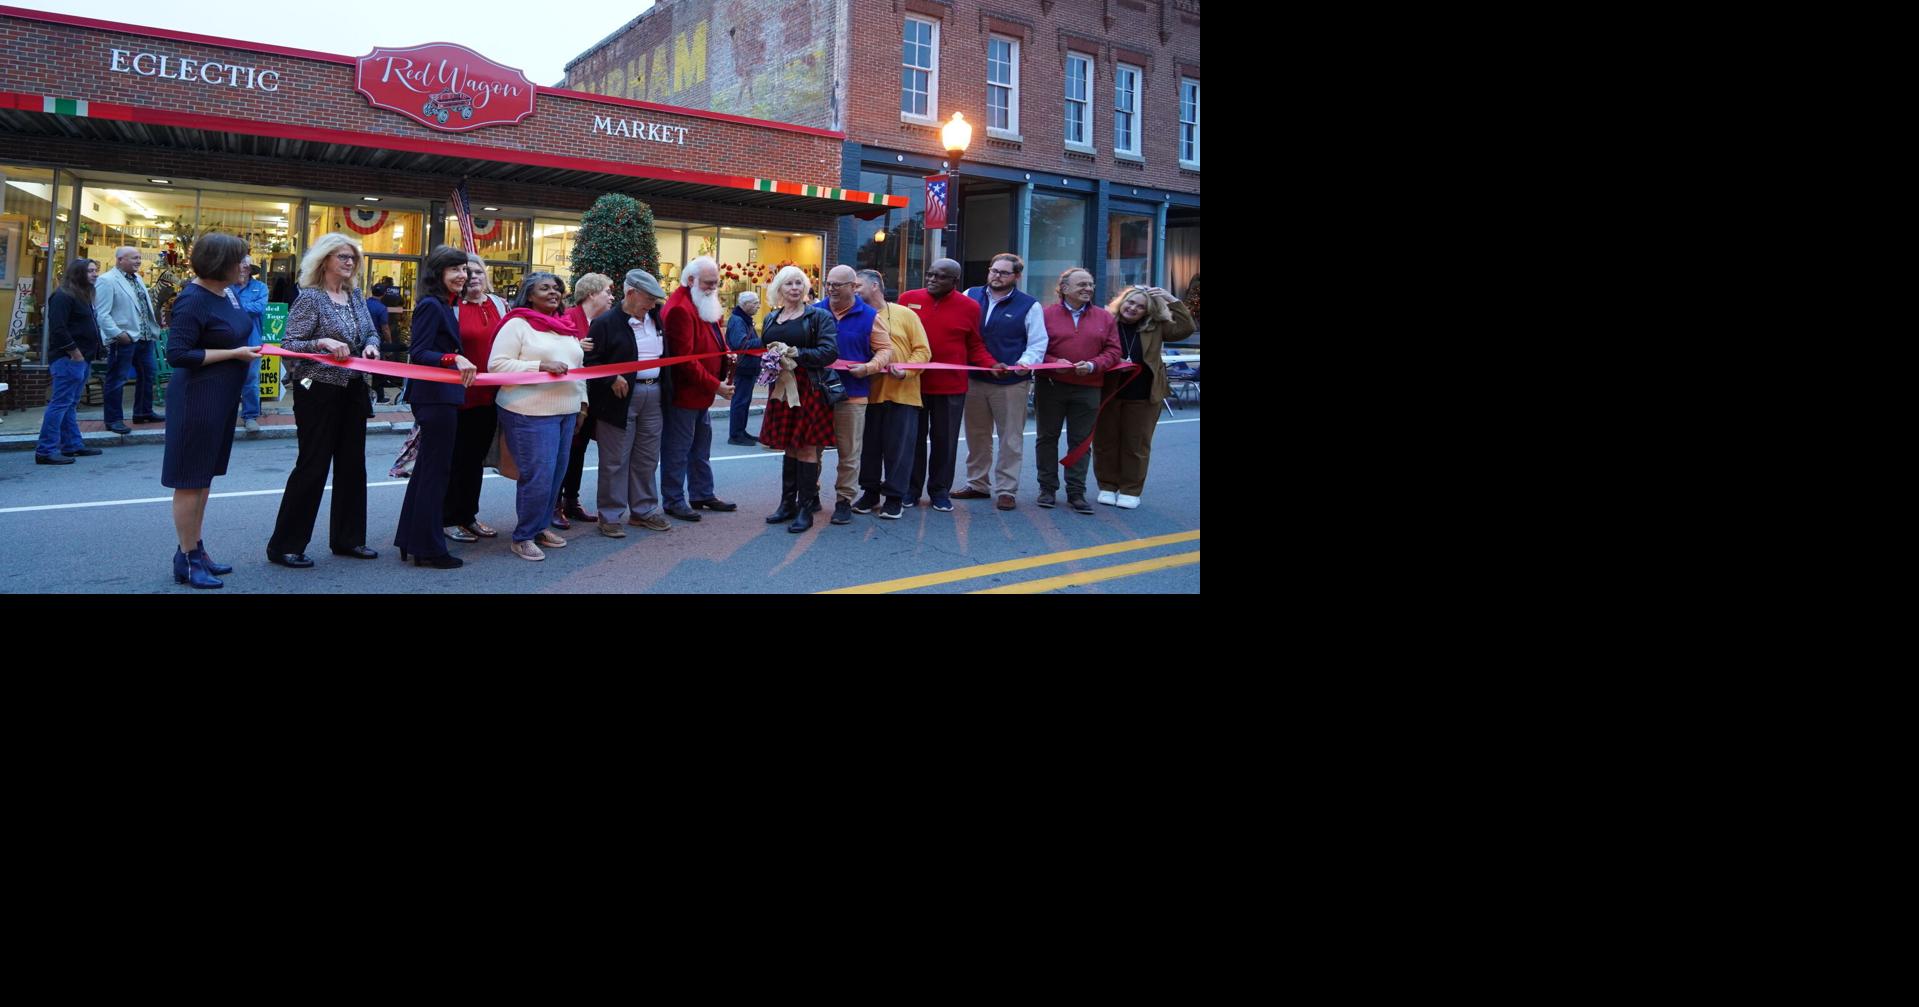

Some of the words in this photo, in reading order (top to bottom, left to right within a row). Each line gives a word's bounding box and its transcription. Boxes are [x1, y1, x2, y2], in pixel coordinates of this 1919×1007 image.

[110, 48, 280, 92] ECLECTIC
[376, 56, 436, 94] Red
[438, 59, 523, 109] Wagon
[592, 114, 688, 146] MARKET
